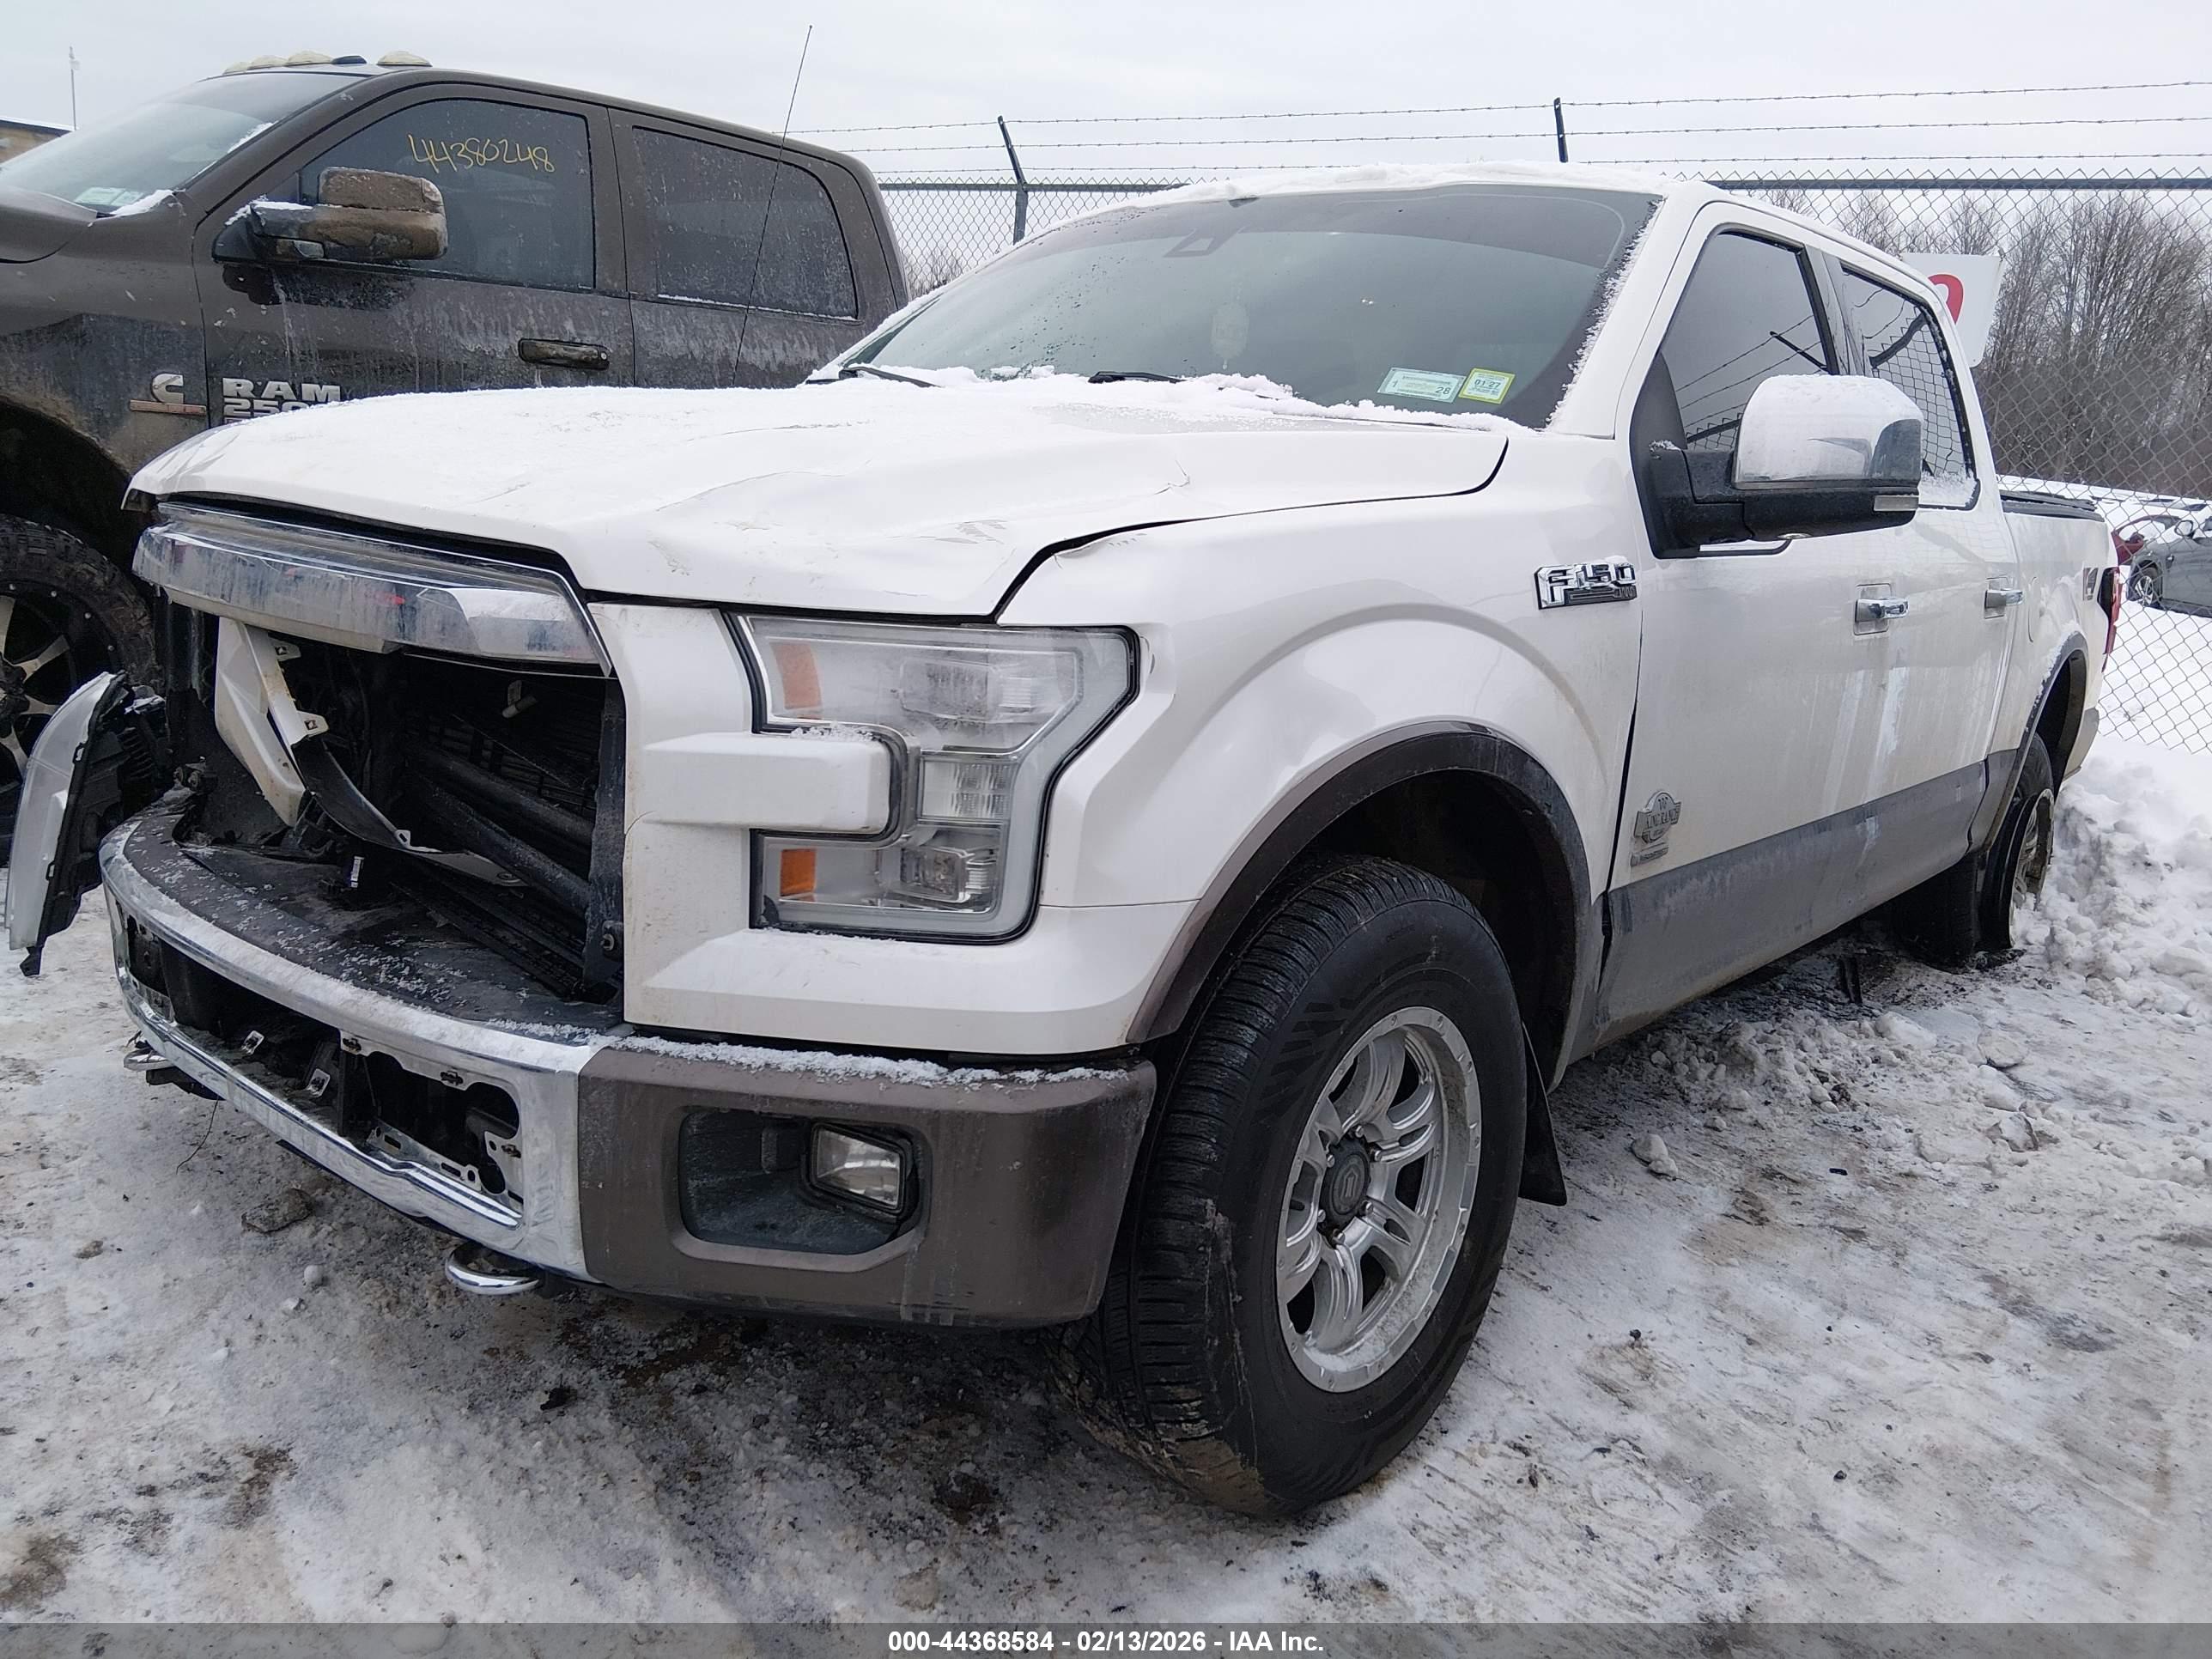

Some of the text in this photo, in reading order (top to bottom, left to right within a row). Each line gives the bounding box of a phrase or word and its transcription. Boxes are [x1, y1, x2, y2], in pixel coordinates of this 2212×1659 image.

[408, 134, 556, 173] 44380248
[222, 378, 341, 402] RAM
[1435, 386, 1451, 395] 28
